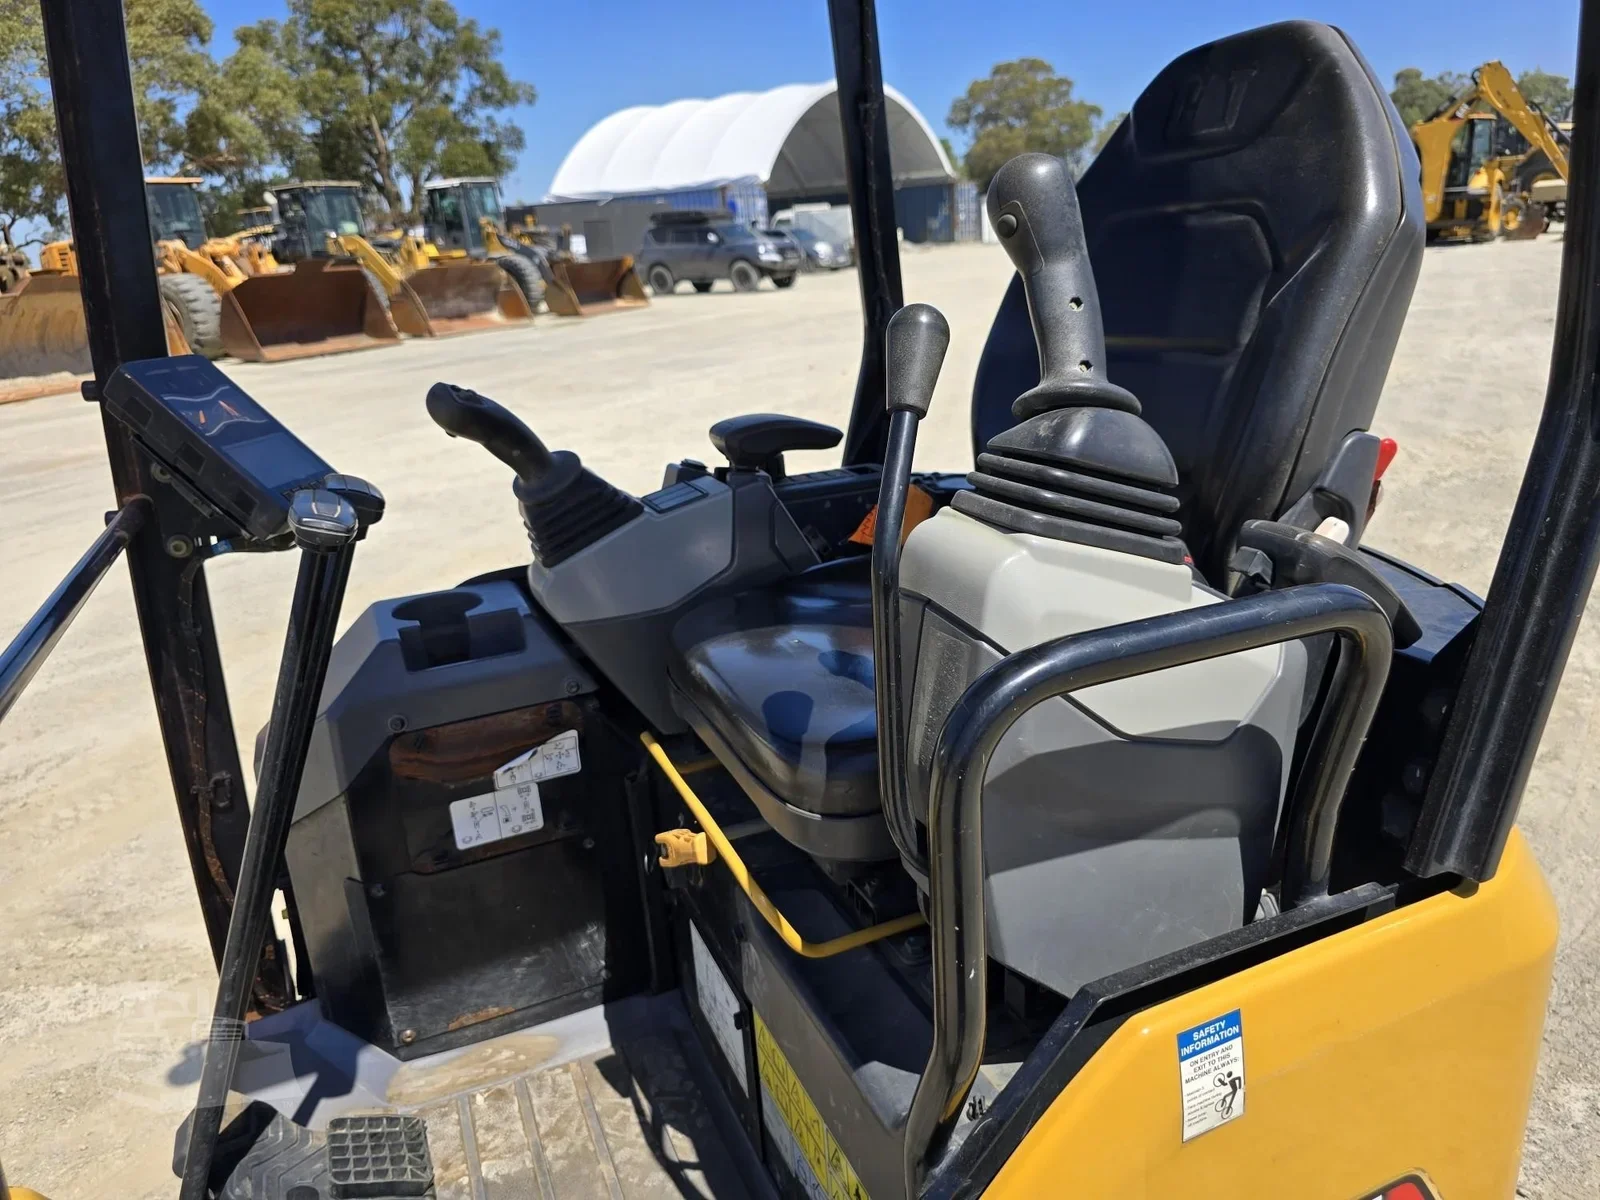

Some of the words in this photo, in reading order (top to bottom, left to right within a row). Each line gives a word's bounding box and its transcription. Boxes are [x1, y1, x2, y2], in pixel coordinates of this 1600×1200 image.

[1181, 1025, 1239, 1056] INFORMATION
[1193, 1020, 1226, 1040] SAFETY
[1189, 1059, 1199, 1067] ON
[1199, 1050, 1220, 1063] ENTRY
[1220, 1044, 1233, 1054] AND
[1193, 1063, 1207, 1073] EXIT
[1207, 1059, 1216, 1067] TO
[1217, 1052, 1231, 1062] THIS
[1185, 1067, 1212, 1084] MACHINE
[1213, 1056, 1240, 1072] ALWAYS:
